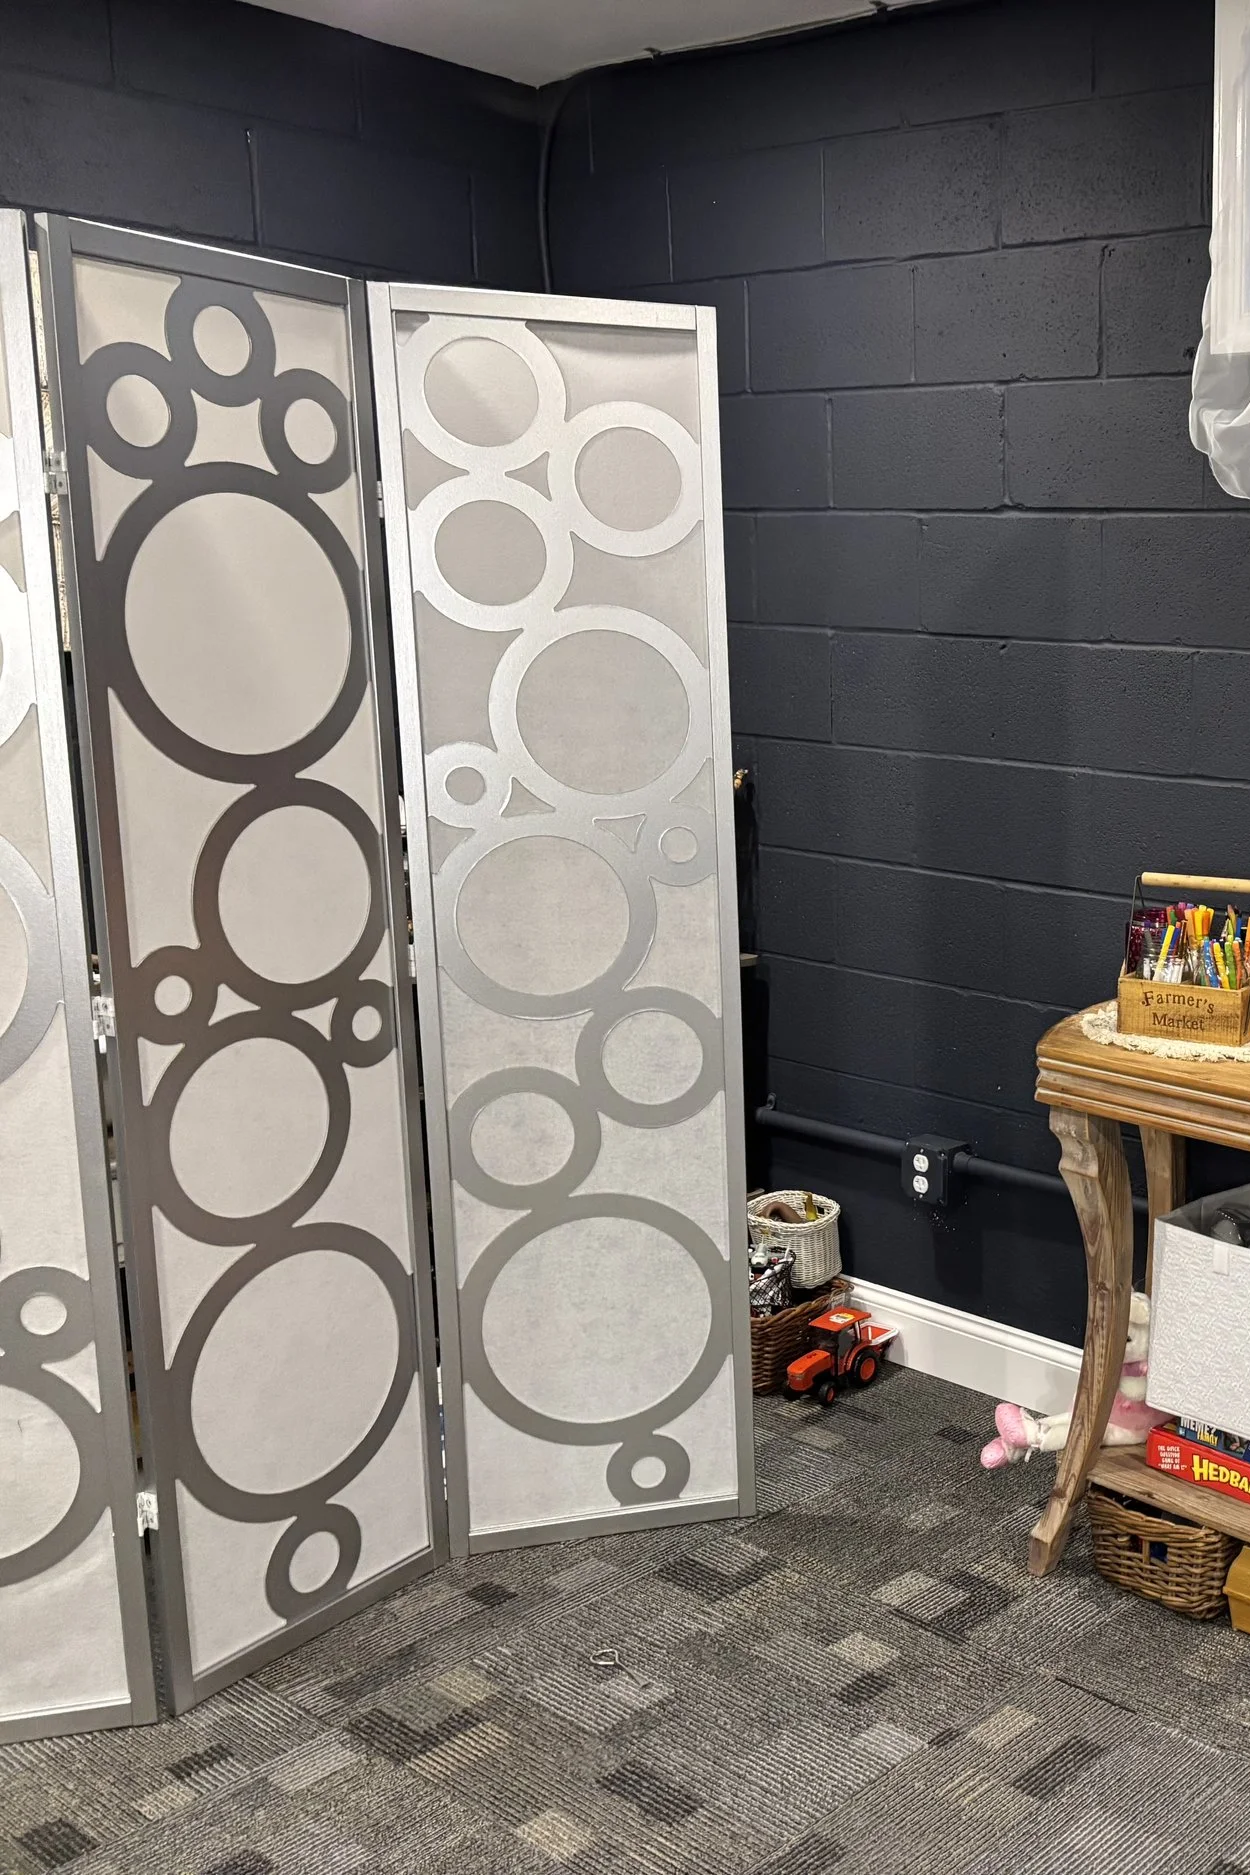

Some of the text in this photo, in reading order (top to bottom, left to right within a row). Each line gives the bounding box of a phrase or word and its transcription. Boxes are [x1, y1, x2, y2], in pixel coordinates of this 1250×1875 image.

[1142, 990, 1215, 1014] Farmer's
[1152, 1012, 1206, 1031] Market
[1197, 1431, 1218, 1447] FAMILY
